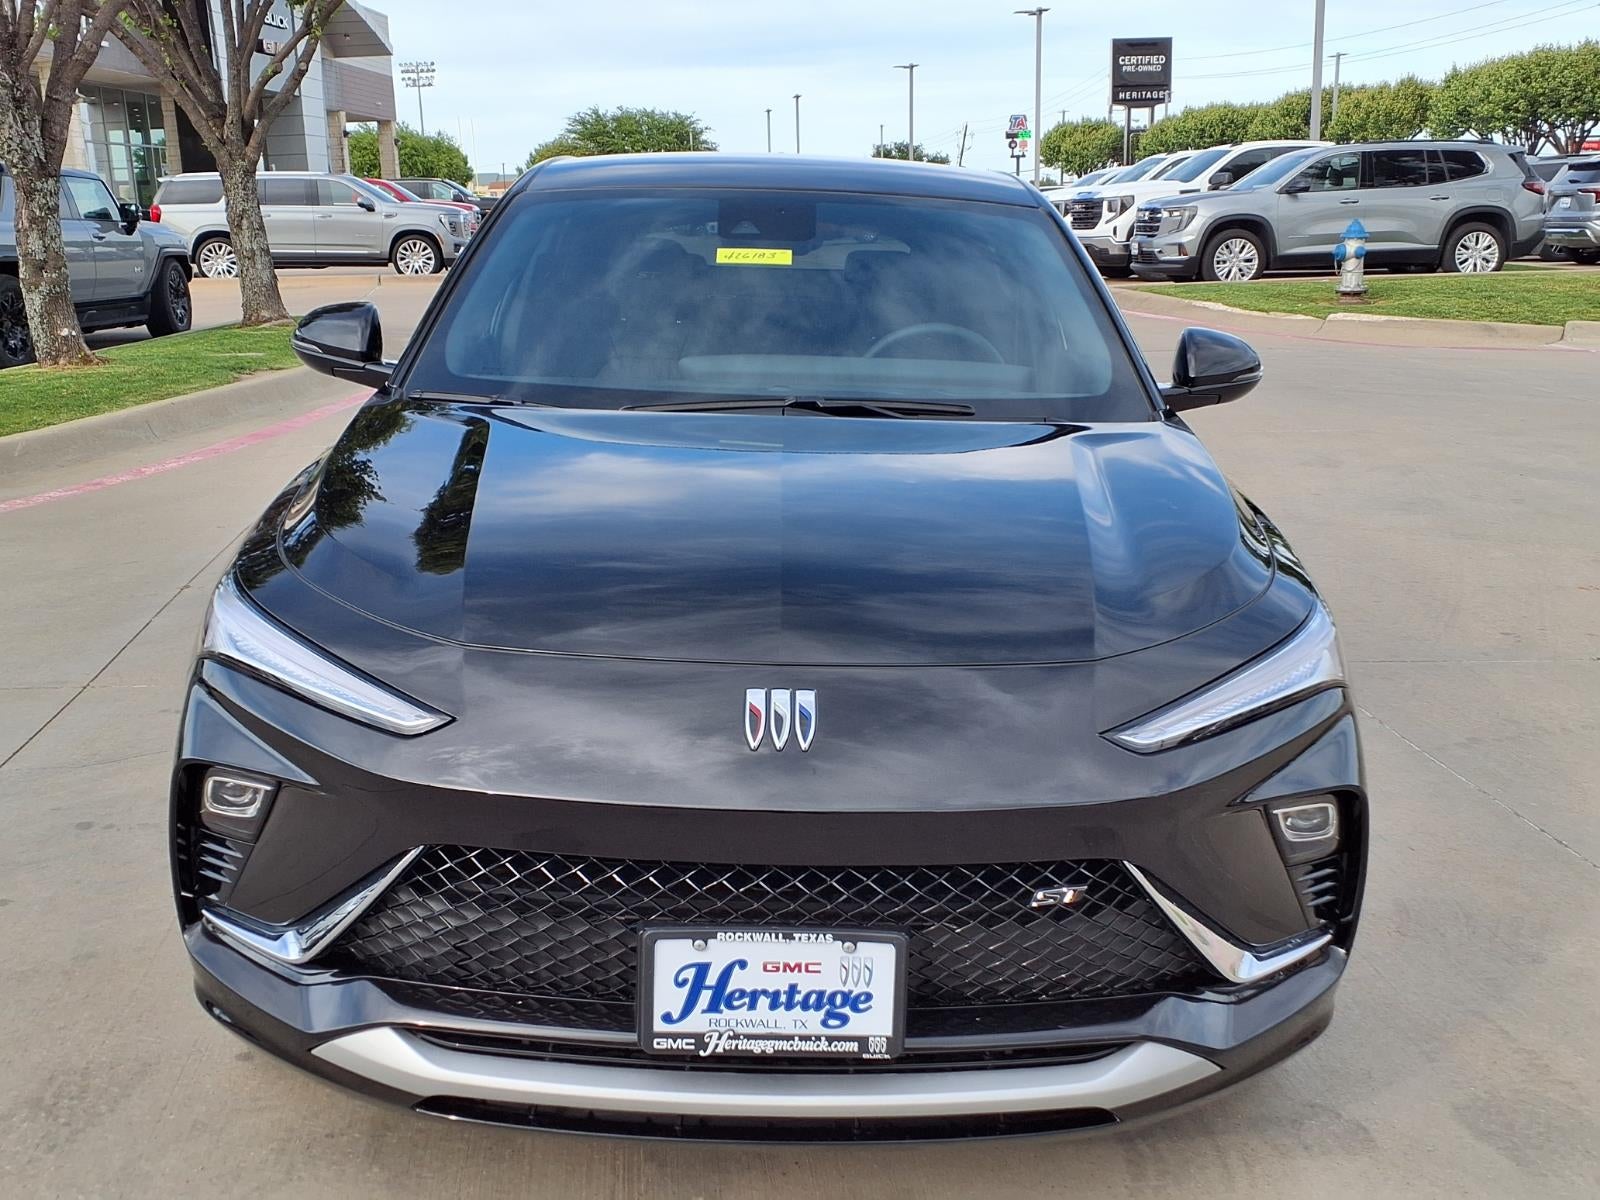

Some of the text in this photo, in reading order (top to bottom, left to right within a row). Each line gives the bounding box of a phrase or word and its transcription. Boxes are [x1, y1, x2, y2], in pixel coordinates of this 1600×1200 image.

[1118, 55, 1166, 65] CERTIFIED
[1118, 90, 1166, 100] HERITAGE
[1031, 886, 1088, 908] ST
[716, 931, 834, 944] ROCKWALL, TEXAS
[762, 961, 822, 974] GMC
[660, 958, 874, 1030] Heritage
[708, 1018, 808, 1030] ROCKWALL, TX
[653, 1030, 859, 1057] GMC Heritagegmcbuick.com
